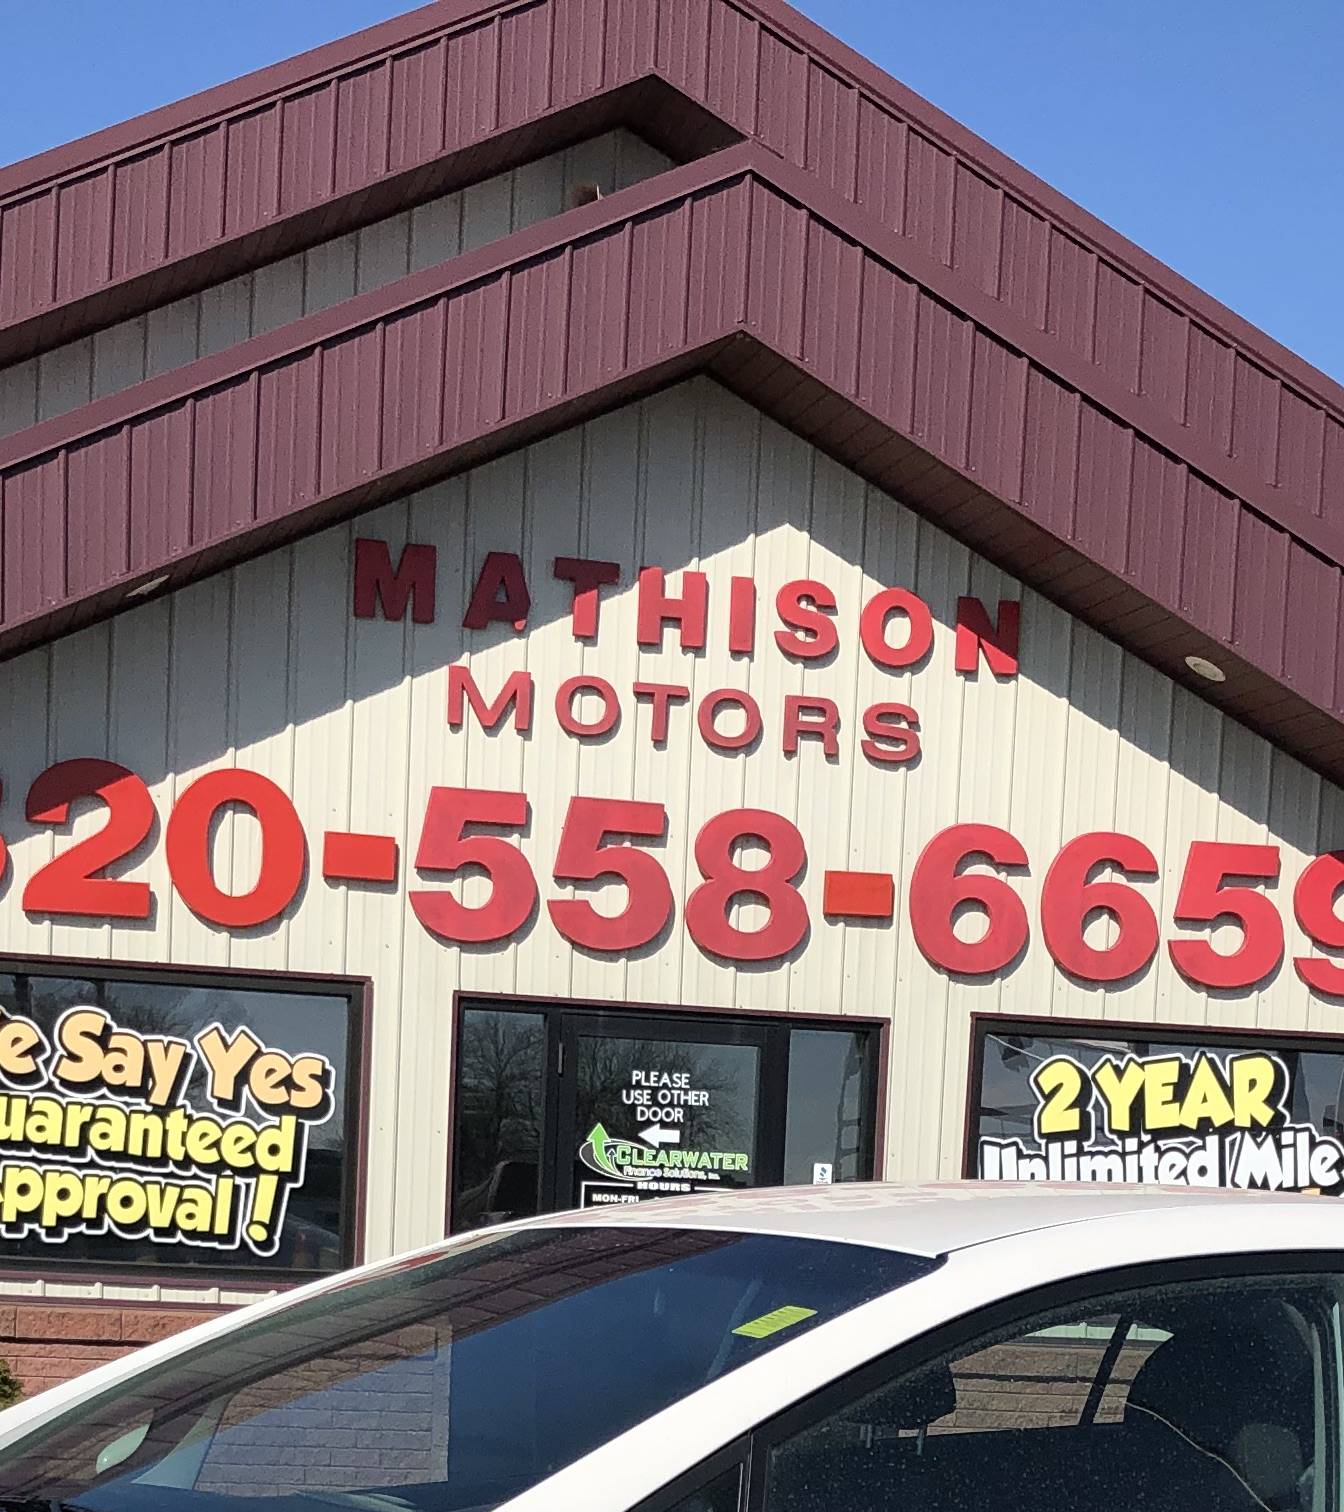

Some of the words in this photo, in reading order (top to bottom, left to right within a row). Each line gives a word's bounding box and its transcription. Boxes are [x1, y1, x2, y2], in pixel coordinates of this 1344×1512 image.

[352, 537, 1021, 677] MATHISON
[447, 664, 921, 764] MOTORS
[56, 1009, 188, 1106] Say
[198, 1026, 325, 1109] Yes
[631, 1070, 691, 1090] PLEASE
[621, 1089, 653, 1106] USE
[657, 1089, 710, 1107] OTHER
[1037, 1058, 1083, 1135] 2
[1094, 1051, 1277, 1133] YEAR
[636, 1106, 685, 1123] DOOR
[615, 1145, 749, 1171] CLEARWATER
[982, 1136, 1219, 1188] Unlimited
[1233, 1130, 1344, 1192] Mile
[623, 1165, 662, 1178] Finance
[636, 1181, 692, 1192] HOURS
[592, 1193, 640, 1204] MON-FRI
